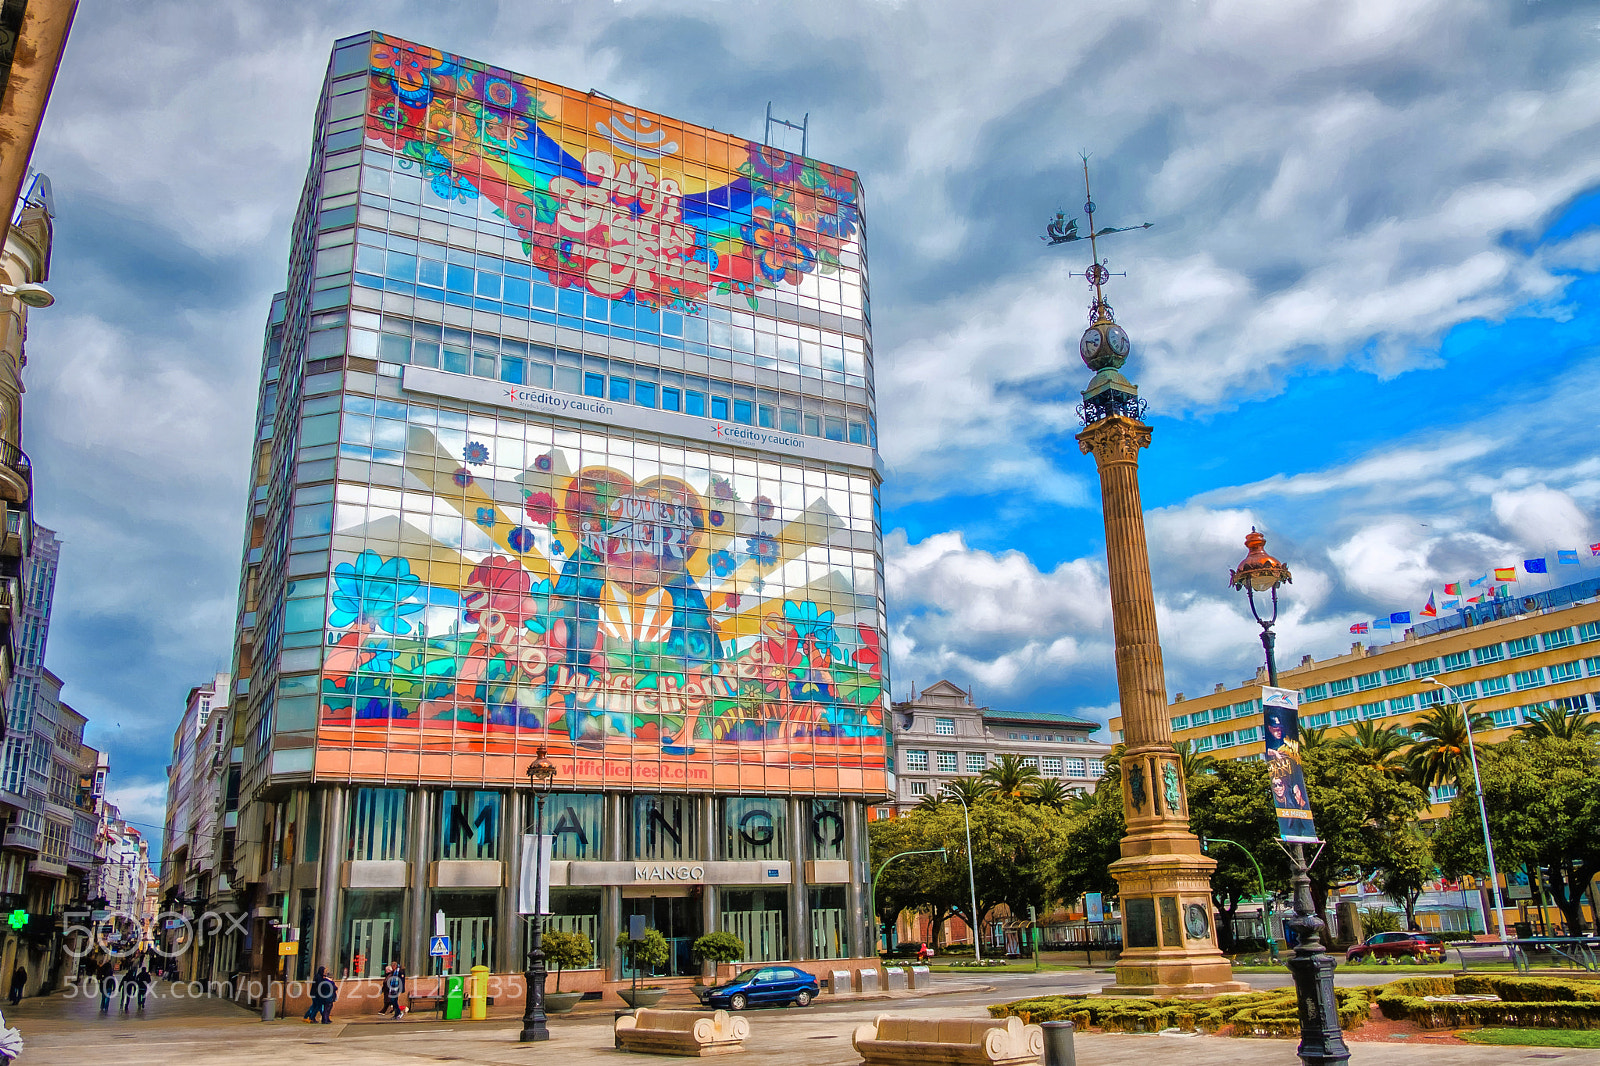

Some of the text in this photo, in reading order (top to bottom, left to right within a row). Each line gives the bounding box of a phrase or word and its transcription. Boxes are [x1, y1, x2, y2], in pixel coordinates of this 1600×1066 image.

[519, 391, 613, 415] crédito y caución
[724, 427, 805, 449] crédito y caución
[634, 866, 705, 880] MANGO
